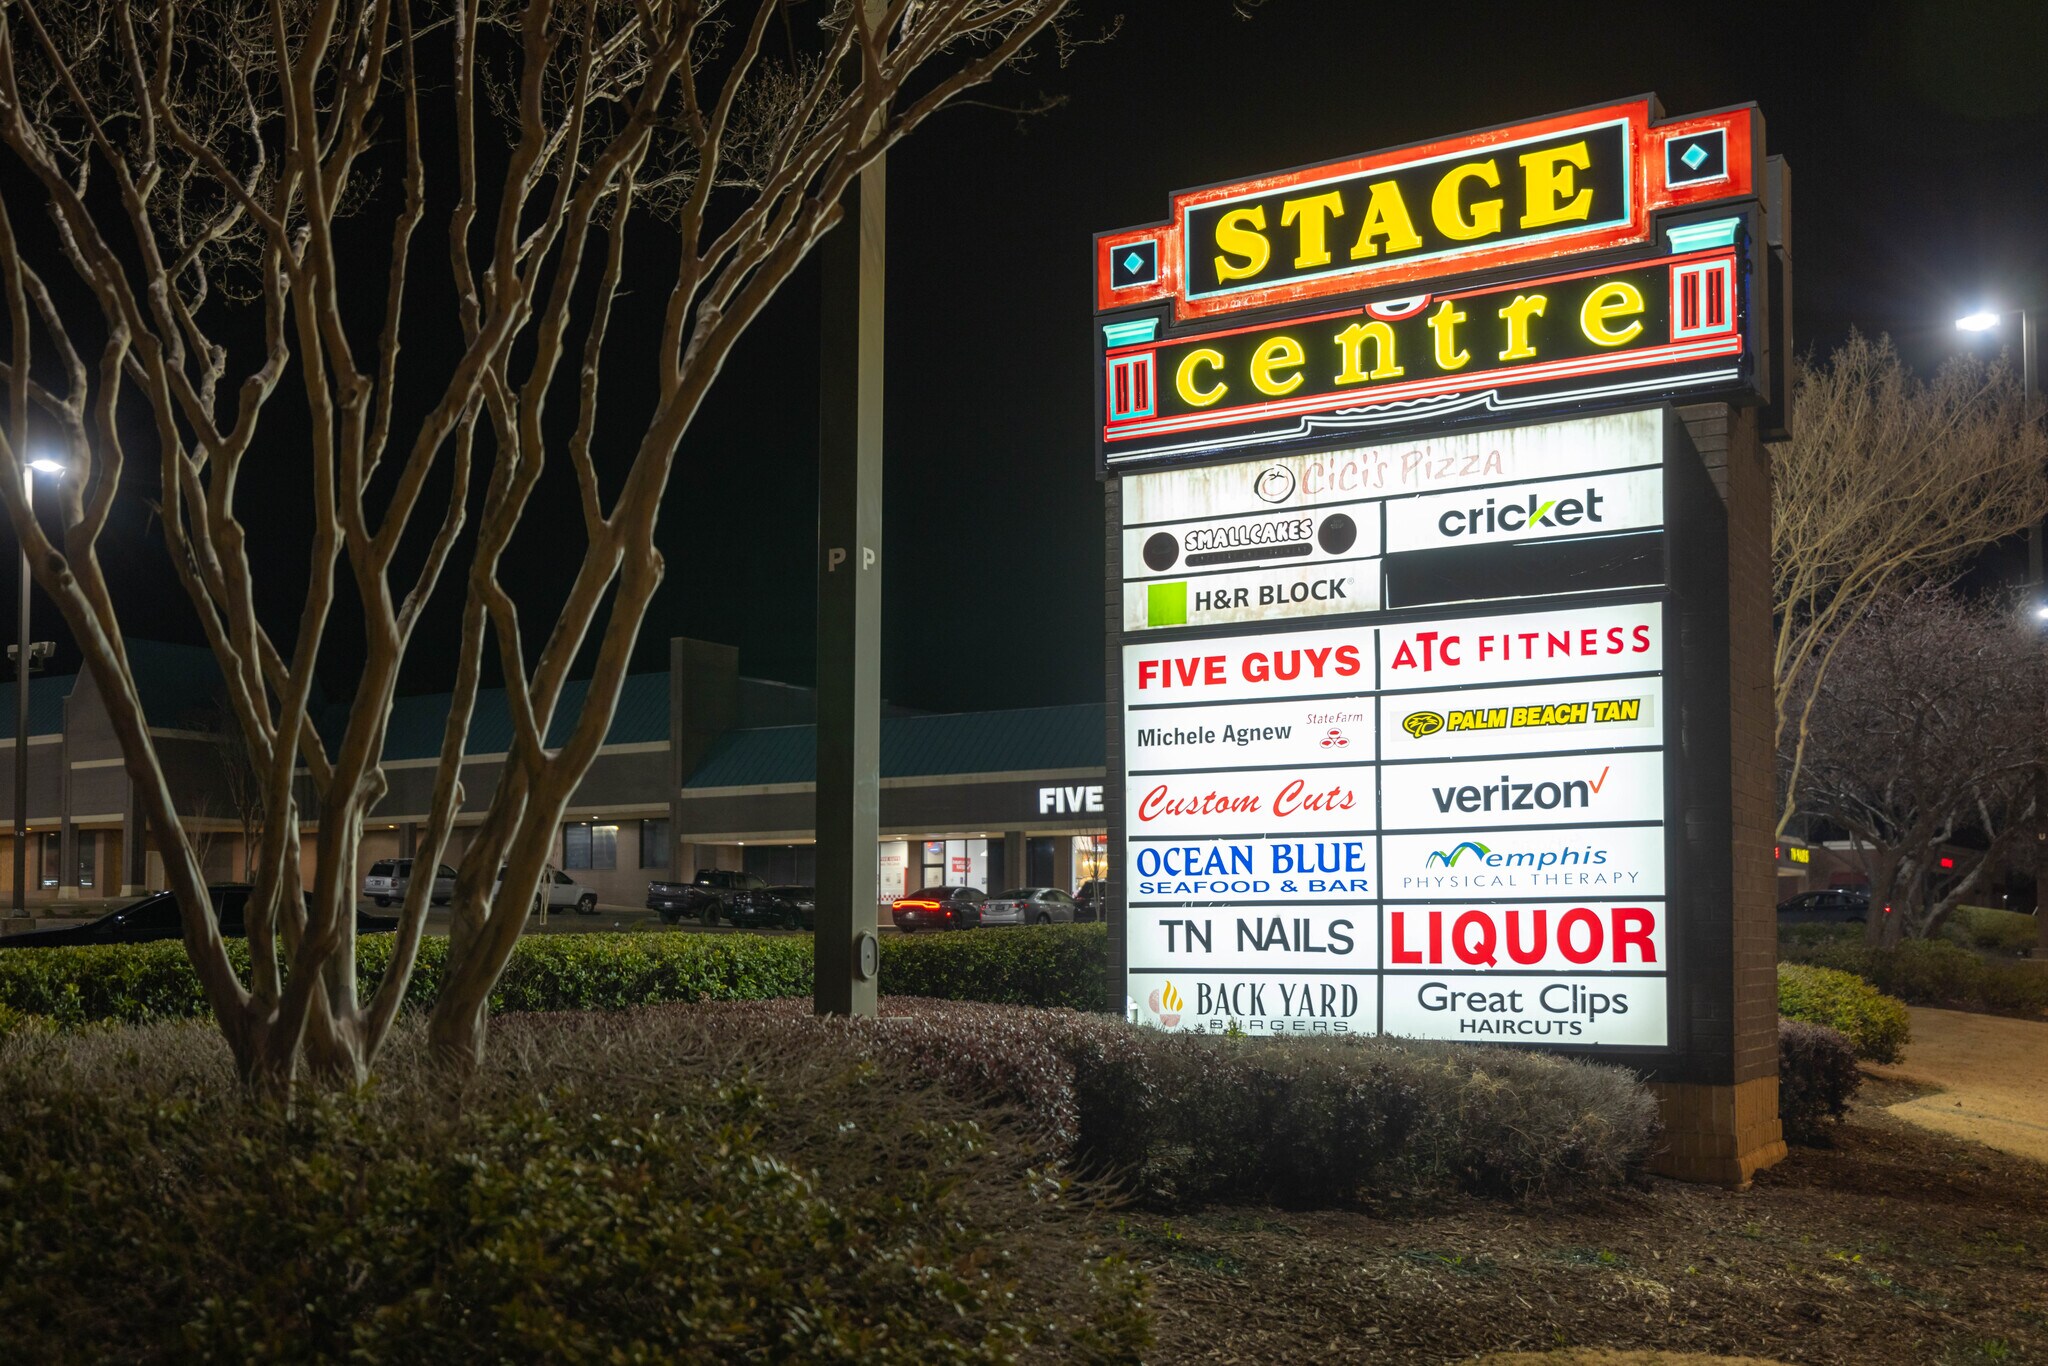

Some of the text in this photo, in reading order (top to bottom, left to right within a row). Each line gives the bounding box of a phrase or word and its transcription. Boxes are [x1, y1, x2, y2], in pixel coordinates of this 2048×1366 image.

[1214, 140, 1594, 285] STAGE
[1175, 281, 1645, 407] centre
[1438, 487, 1604, 537] cricket
[1185, 518, 1313, 551] SMALLCAKES
[828, 547, 846, 572] P
[863, 546, 875, 570] P
[1195, 578, 1347, 611] H&R BLOCK
[1391, 625, 1650, 672] ATC FITNESS
[1138, 645, 1361, 689] FIVE GUYS
[1446, 698, 1641, 732] PALM BEACH TAN
[1137, 724, 1292, 747] Michele Agnew
[1039, 785, 1105, 815] FIVE
[1138, 779, 1357, 822] Custom Cuts
[1432, 775, 1589, 813] verizon
[1136, 842, 1367, 878] OCEAN BLUE
[1139, 879, 1369, 895] SEAFOOD & BAR
[1403, 871, 1639, 889] PHYSICAL THERAPY
[1159, 916, 1355, 955] TN NAILS
[1391, 907, 1658, 968] LIQUOR
[1196, 982, 1359, 1018] BACK YARD
[1417, 982, 1629, 1023] Great Clips
[1209, 1019, 1349, 1032] BRGERS
[1459, 1019, 1583, 1036] HAIRCUTS
